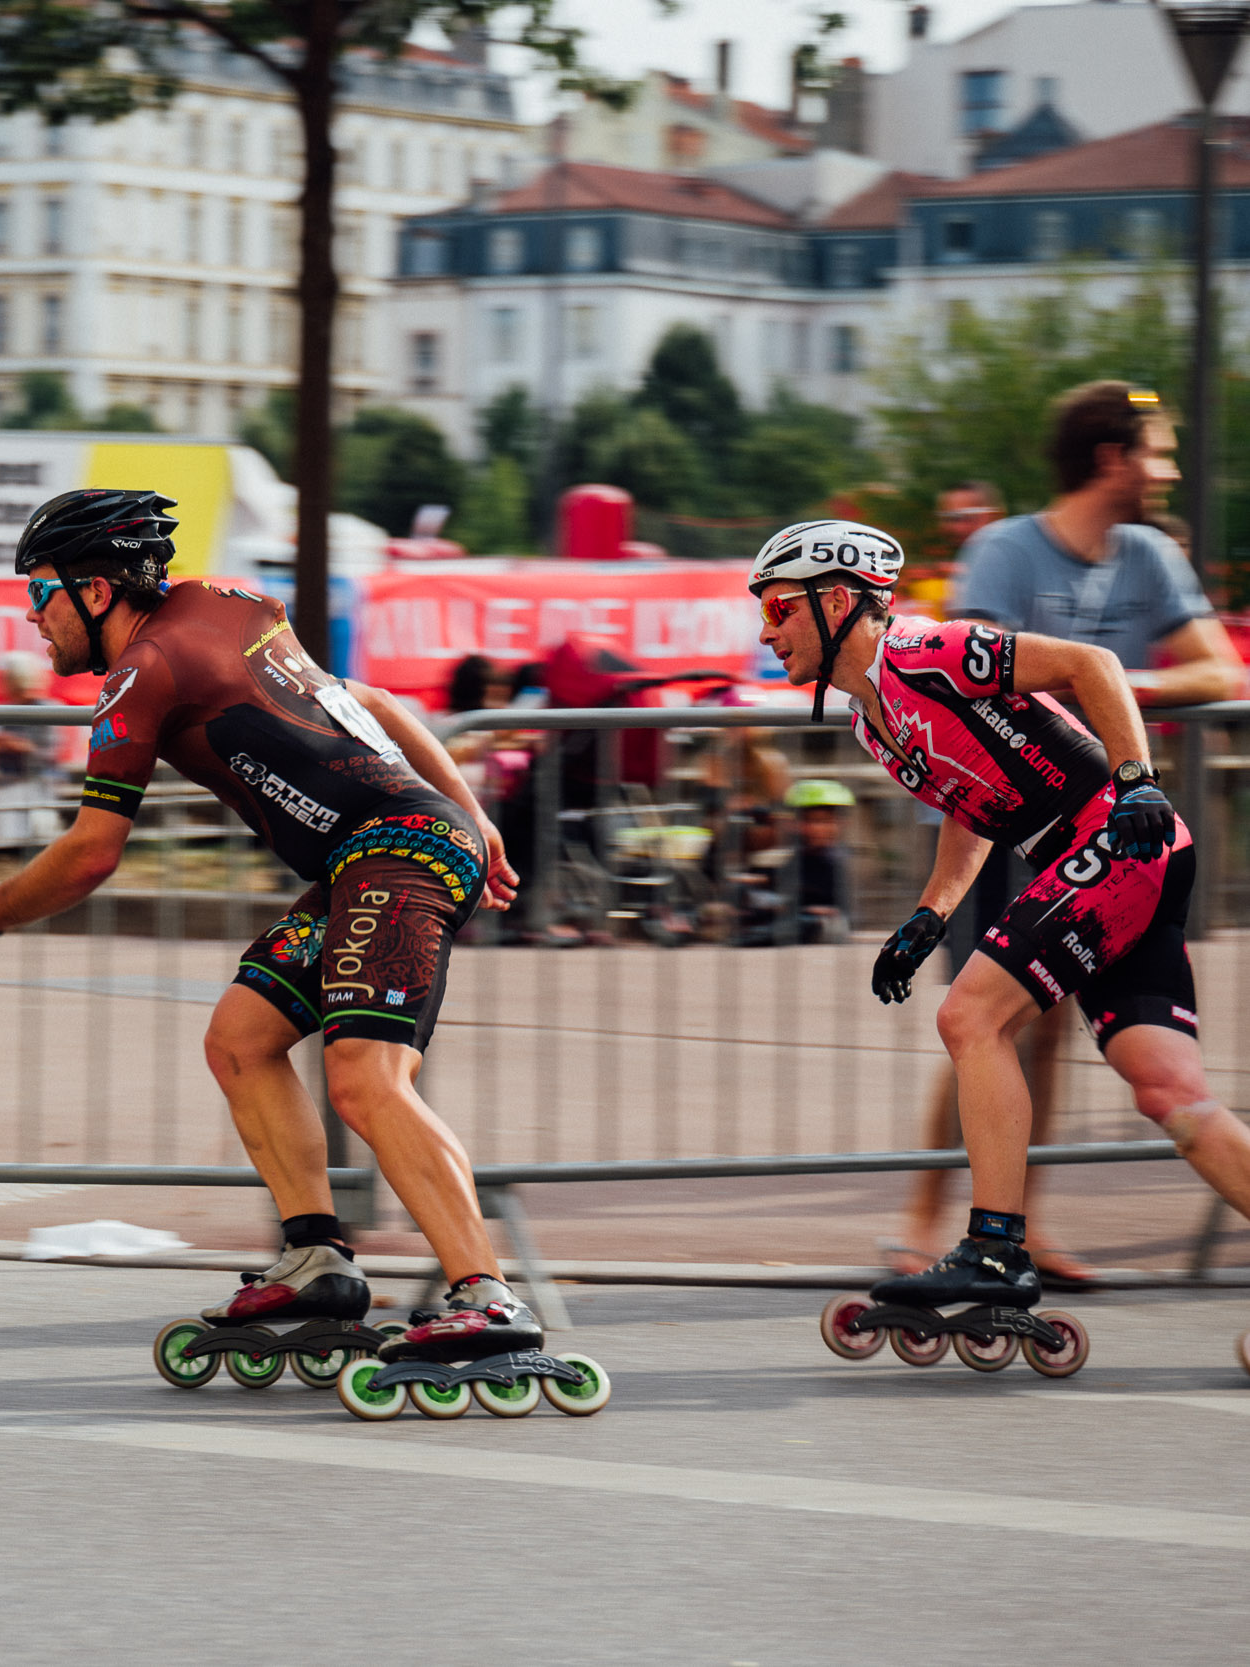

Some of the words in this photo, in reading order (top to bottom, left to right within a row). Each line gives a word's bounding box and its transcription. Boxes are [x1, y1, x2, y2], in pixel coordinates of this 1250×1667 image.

[810, 542, 877, 573] 501
[263, 664, 289, 688] TEAM
[1002, 636, 1014, 679] TEAM
[970, 697, 1014, 741] skate
[261, 782, 333, 834] WHEELS
[266, 773, 341, 823] ATOM
[321, 889, 391, 1000] Jokola
[327, 991, 354, 1004] TEAM
[1026, 958, 1066, 1003] MAPL
